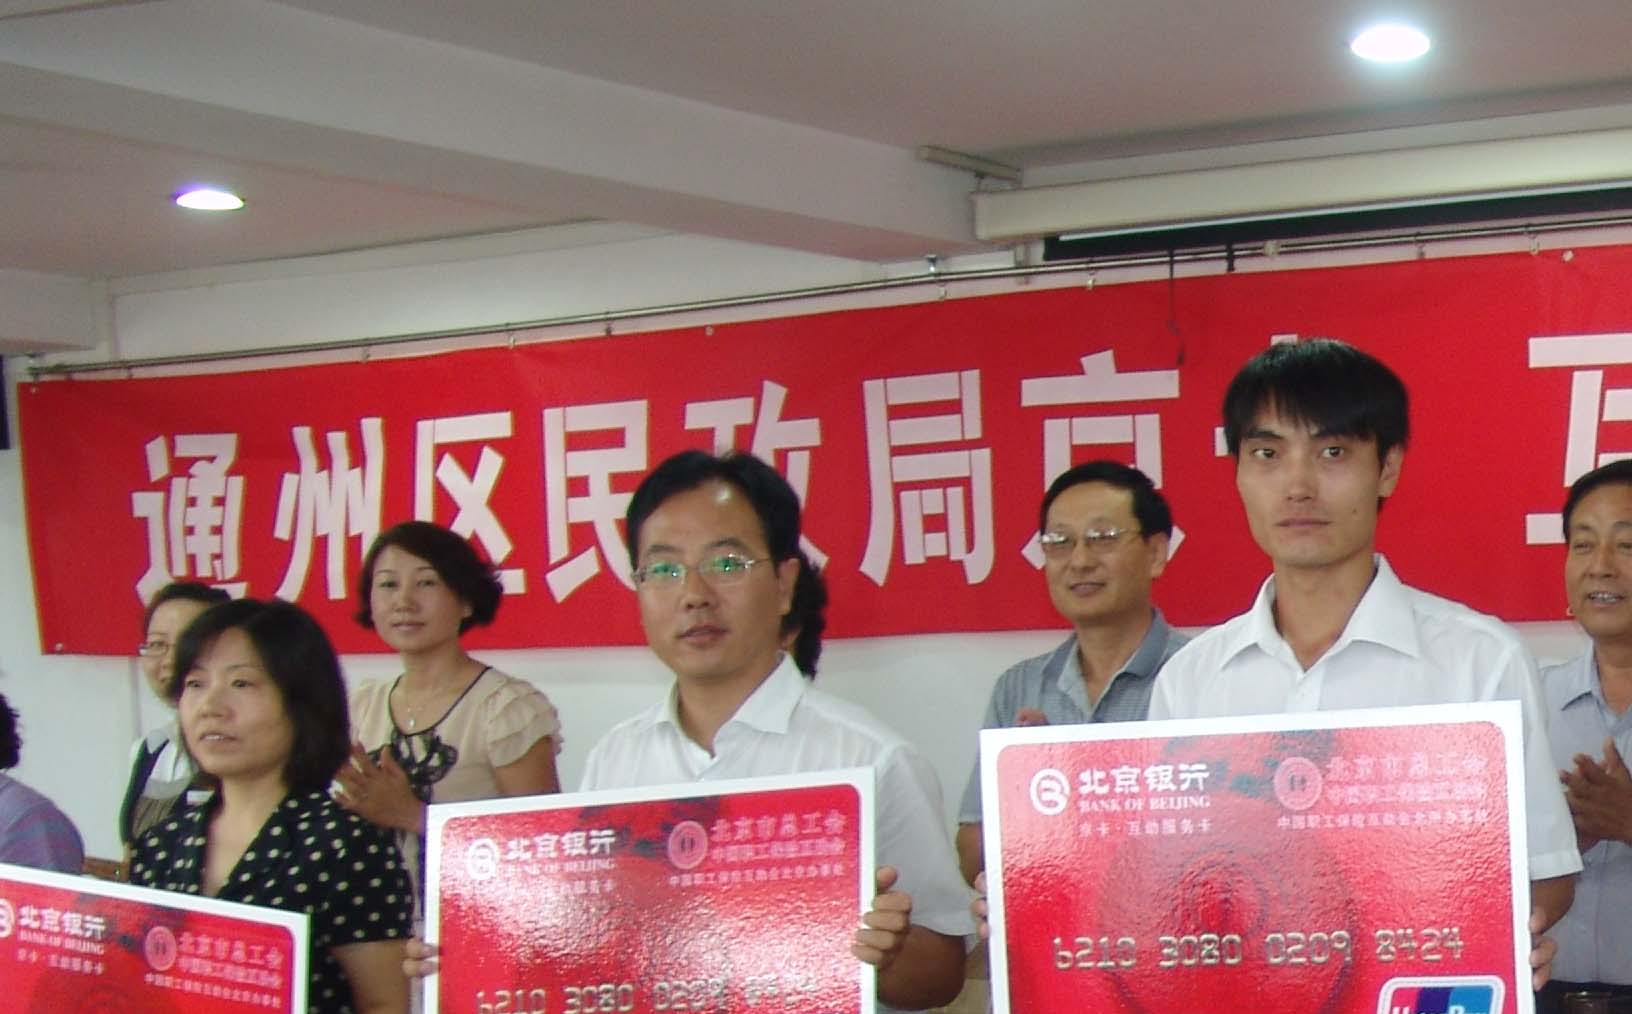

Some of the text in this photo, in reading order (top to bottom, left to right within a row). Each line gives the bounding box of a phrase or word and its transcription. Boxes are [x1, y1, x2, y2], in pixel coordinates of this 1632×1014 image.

[1078, 763, 1211, 795] 北京银行
[1079, 793, 1211, 813] BANK OF BEIJING
[506, 829, 615, 862] 北京银行
[1052, 926, 1465, 972] 6210 3080 0209 8424
